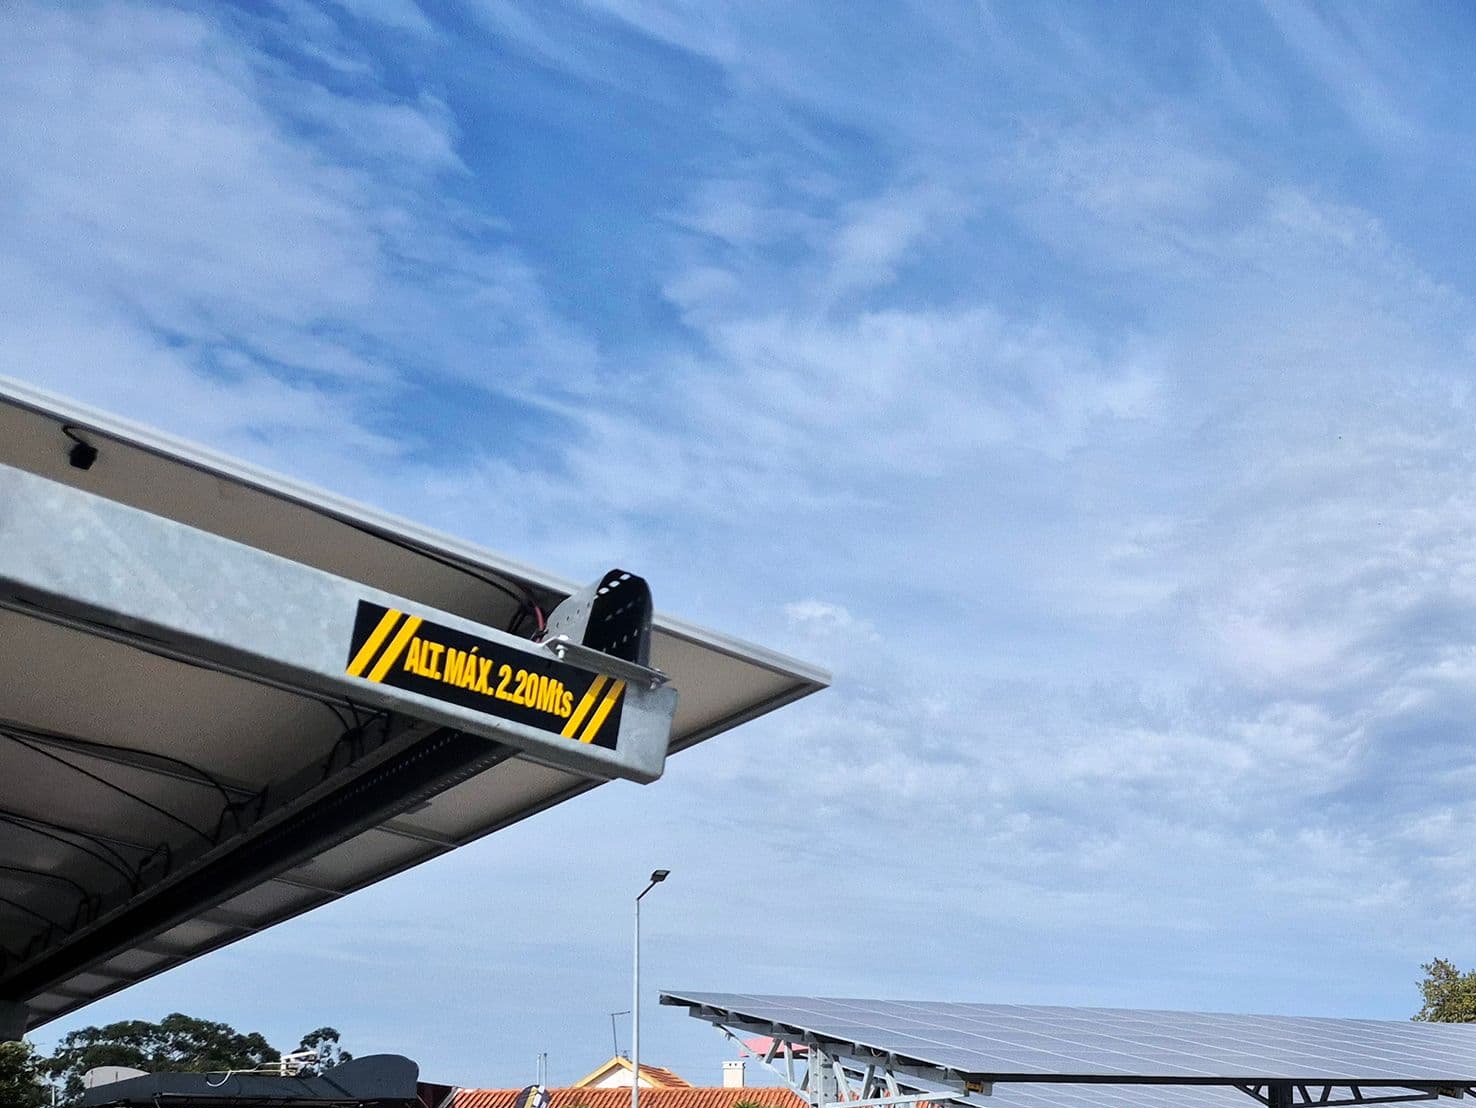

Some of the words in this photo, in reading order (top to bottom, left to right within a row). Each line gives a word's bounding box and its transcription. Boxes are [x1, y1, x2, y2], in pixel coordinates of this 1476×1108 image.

[403, 636, 444, 681] ALT.
[442, 645, 495, 697] MÁX.
[494, 664, 575, 719] 2.20Mts
